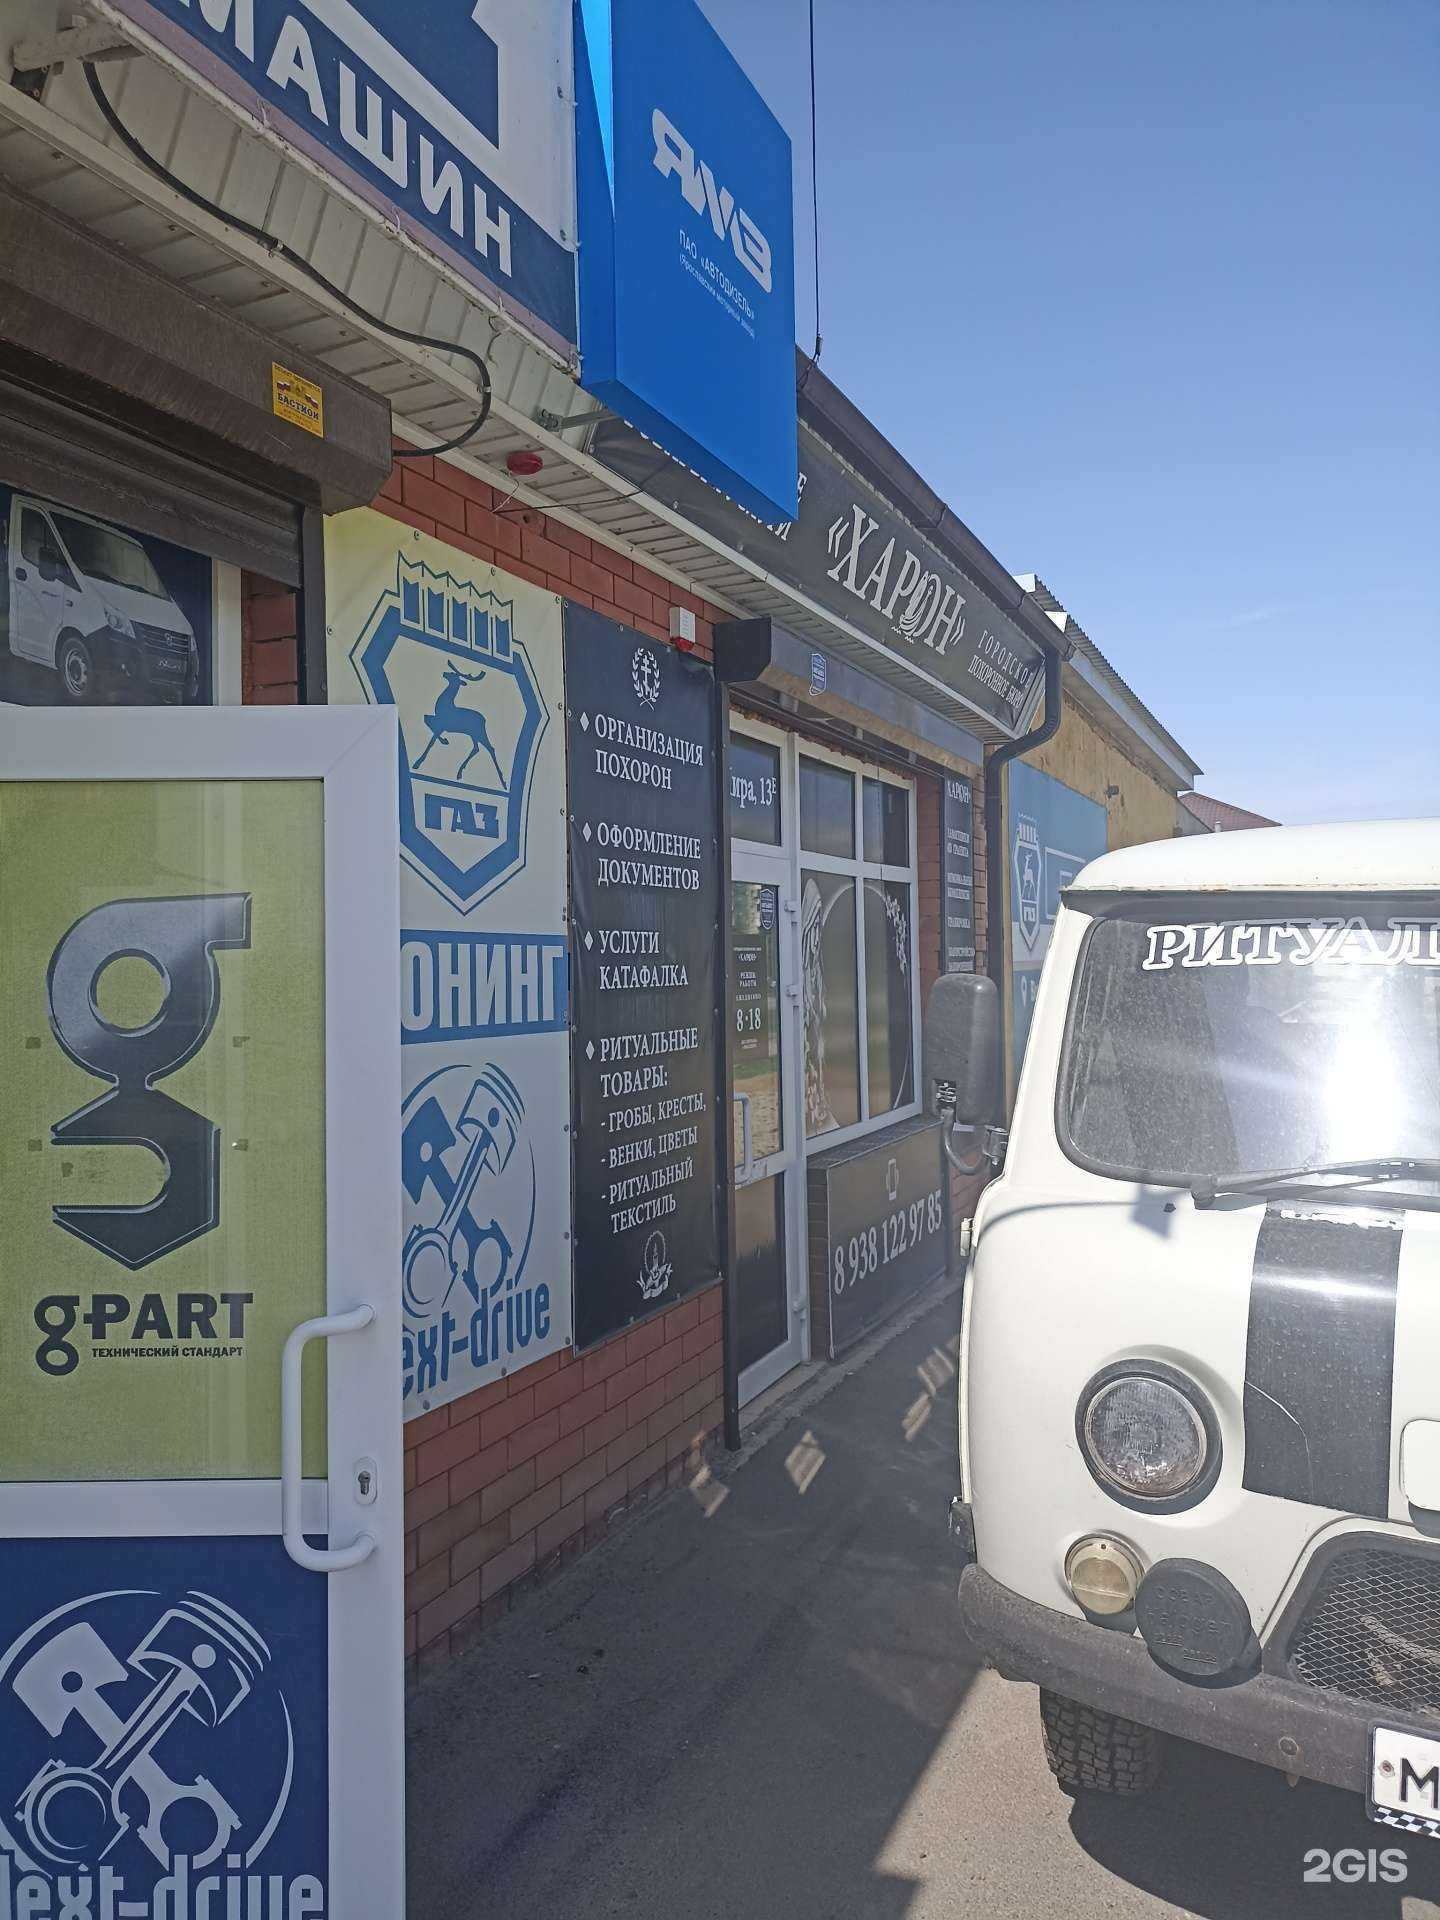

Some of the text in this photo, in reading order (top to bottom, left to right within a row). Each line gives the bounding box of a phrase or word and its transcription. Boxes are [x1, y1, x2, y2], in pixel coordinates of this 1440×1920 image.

[679, 229, 697, 260] ПАО
[827, 503, 967, 656] «ХАРОН»
[594, 713, 704, 766] ОРГАНИЗАЦИЯ
[595, 749, 672, 790] ПОХОРОН
[730, 775, 757, 809] ира,
[424, 793, 500, 839] ГАЗ
[597, 822, 701, 860] ОФОРМЛЕНИЕ
[598, 857, 700, 891] ДОКУМЕНТОВ
[598, 930, 660, 955] УСЛУГИ
[599, 965, 689, 991] КАТАФАЛКА
[600, 1027, 699, 1063] РИТУАЛЬНЫЕ
[601, 1064, 669, 1098] ТОВАРЫ:
[609, 1104, 656, 1133] ГРОБЫ,
[658, 1092, 707, 1121] КРЕСТЫ,
[609, 1138, 656, 1169] ВЕНКИ,
[658, 1126, 698, 1156] ЦВЕТЫ
[609, 1156, 694, 1205] РИТУАЛЬНЫЙ
[611, 1194, 677, 1234] ТЕКСТИЛЬ
[834, 1188, 942, 1295] 8 938 122 97 85
[92, 1346, 244, 1358] ТЕХНИЧЕСКИЙ СТАНДАРТ
